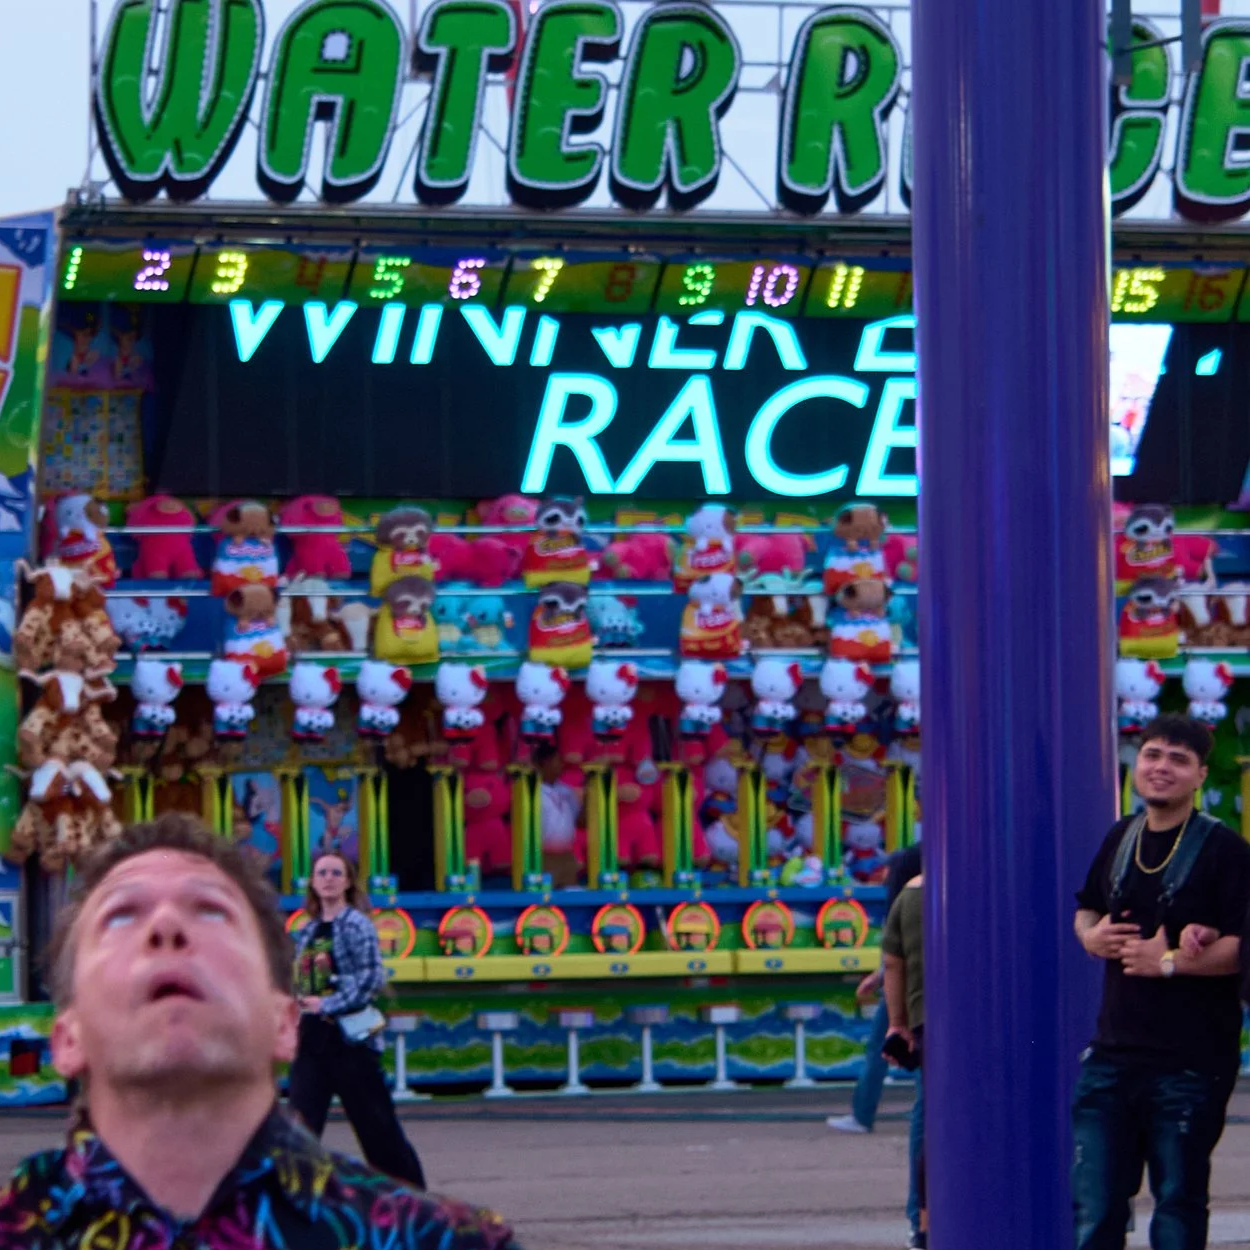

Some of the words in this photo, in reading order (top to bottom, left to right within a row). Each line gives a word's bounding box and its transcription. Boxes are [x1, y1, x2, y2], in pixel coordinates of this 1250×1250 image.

[96, 0, 742, 206] WATER
[780, 4, 1250, 210] RCE
[134, 248, 171, 291] 2
[211, 251, 248, 293] 3
[370, 257, 410, 298] 5
[449, 257, 486, 299] 6
[531, 257, 564, 303] 7
[605, 263, 636, 302] 8
[679, 264, 715, 306] 9
[746, 264, 799, 307] 10
[827, 263, 864, 308] 11
[1111, 267, 1166, 313] 15
[520, 372, 920, 497] RACE
